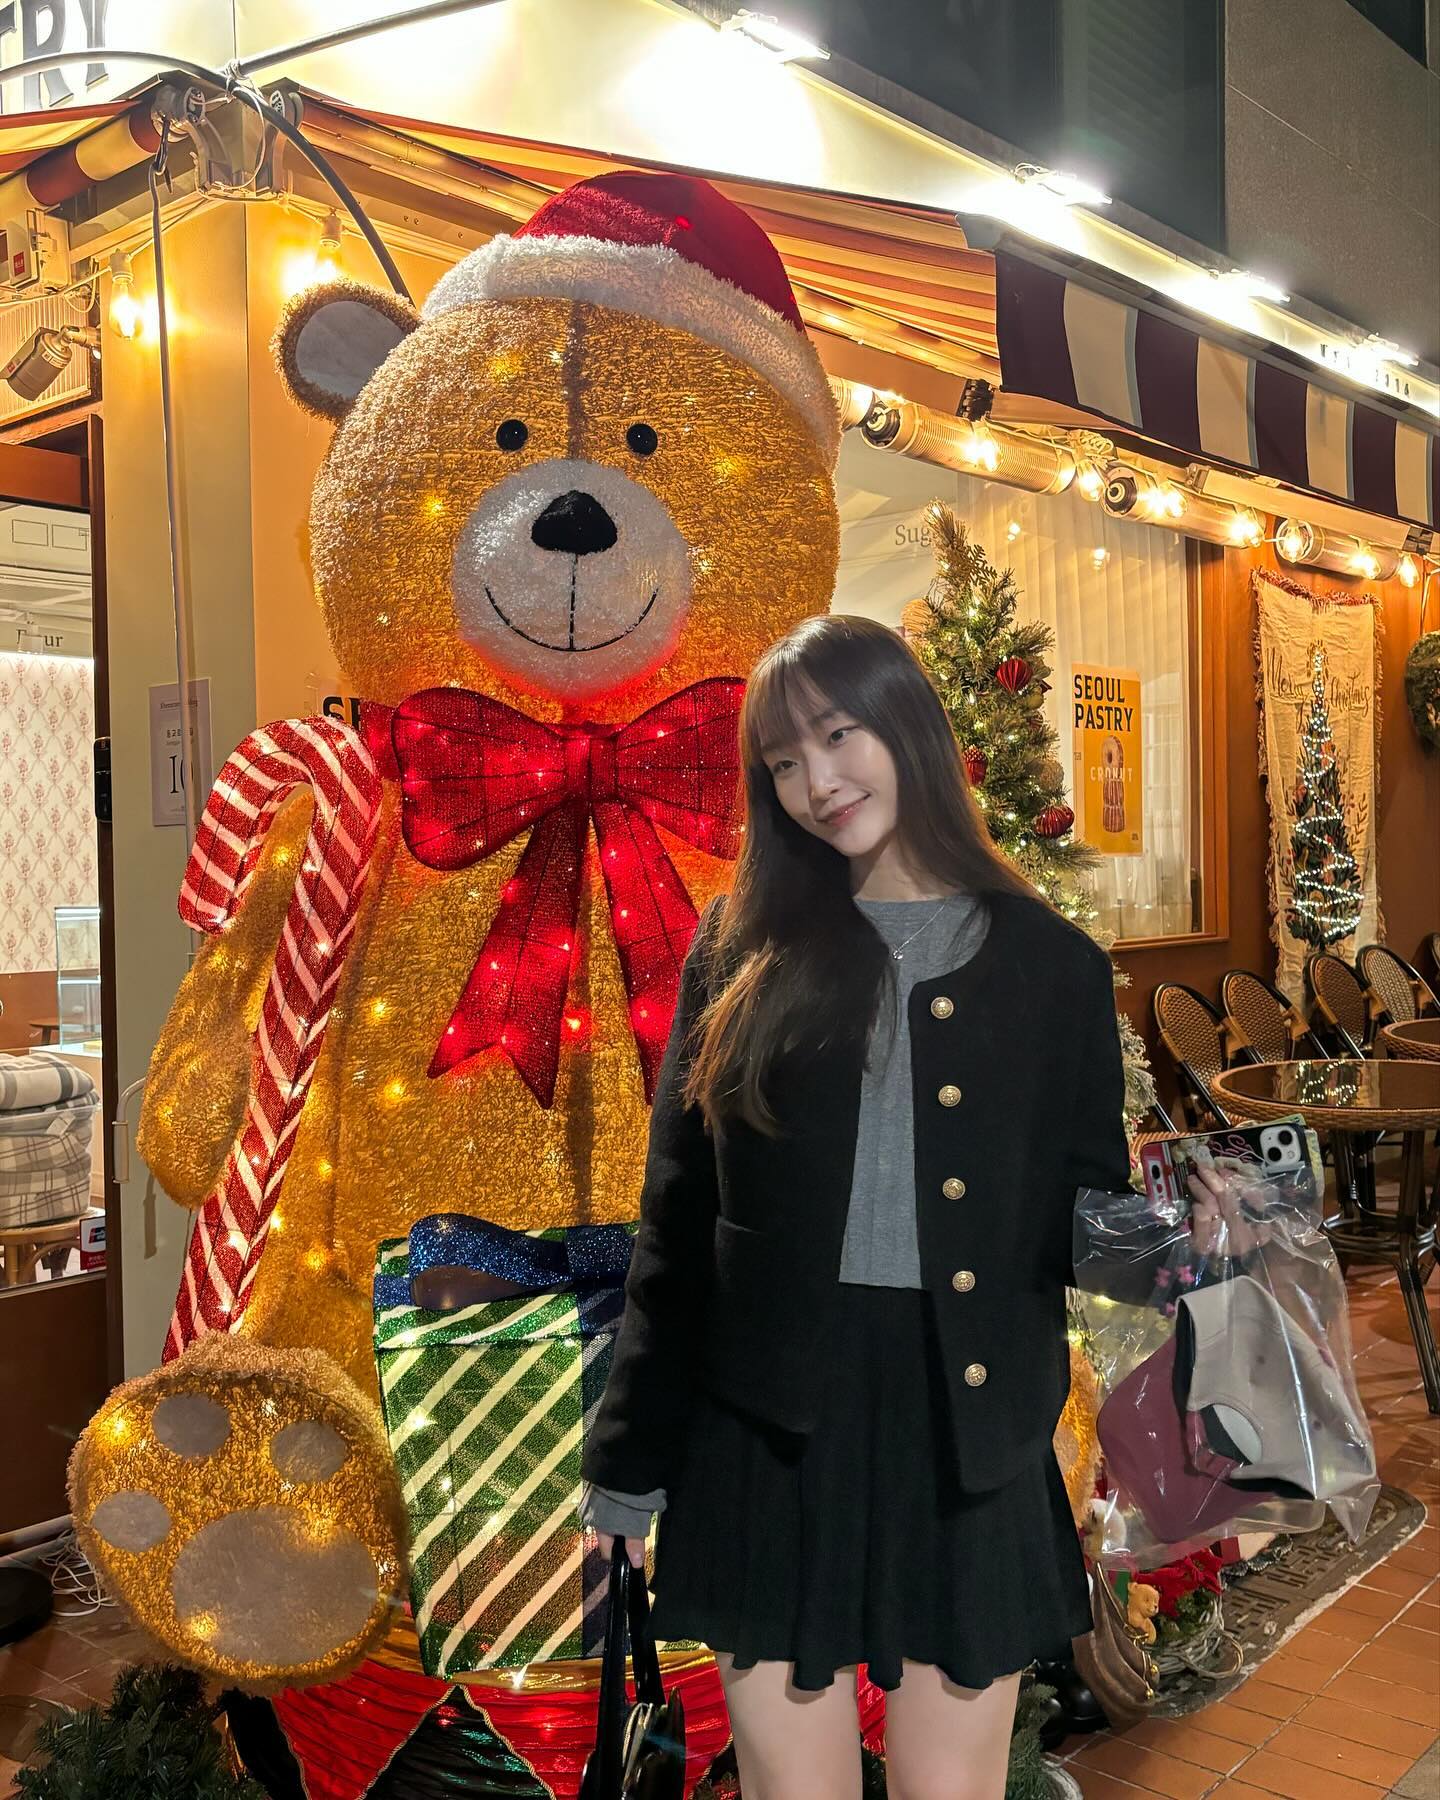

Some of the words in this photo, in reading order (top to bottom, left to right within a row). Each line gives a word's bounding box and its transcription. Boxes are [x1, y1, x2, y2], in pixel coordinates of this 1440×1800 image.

[0, 0, 109, 108] RY
[1074, 674, 1125, 703] SEOUL
[1074, 703, 1133, 732] PASTRY
[1090, 766, 1133, 783] CRONUT
